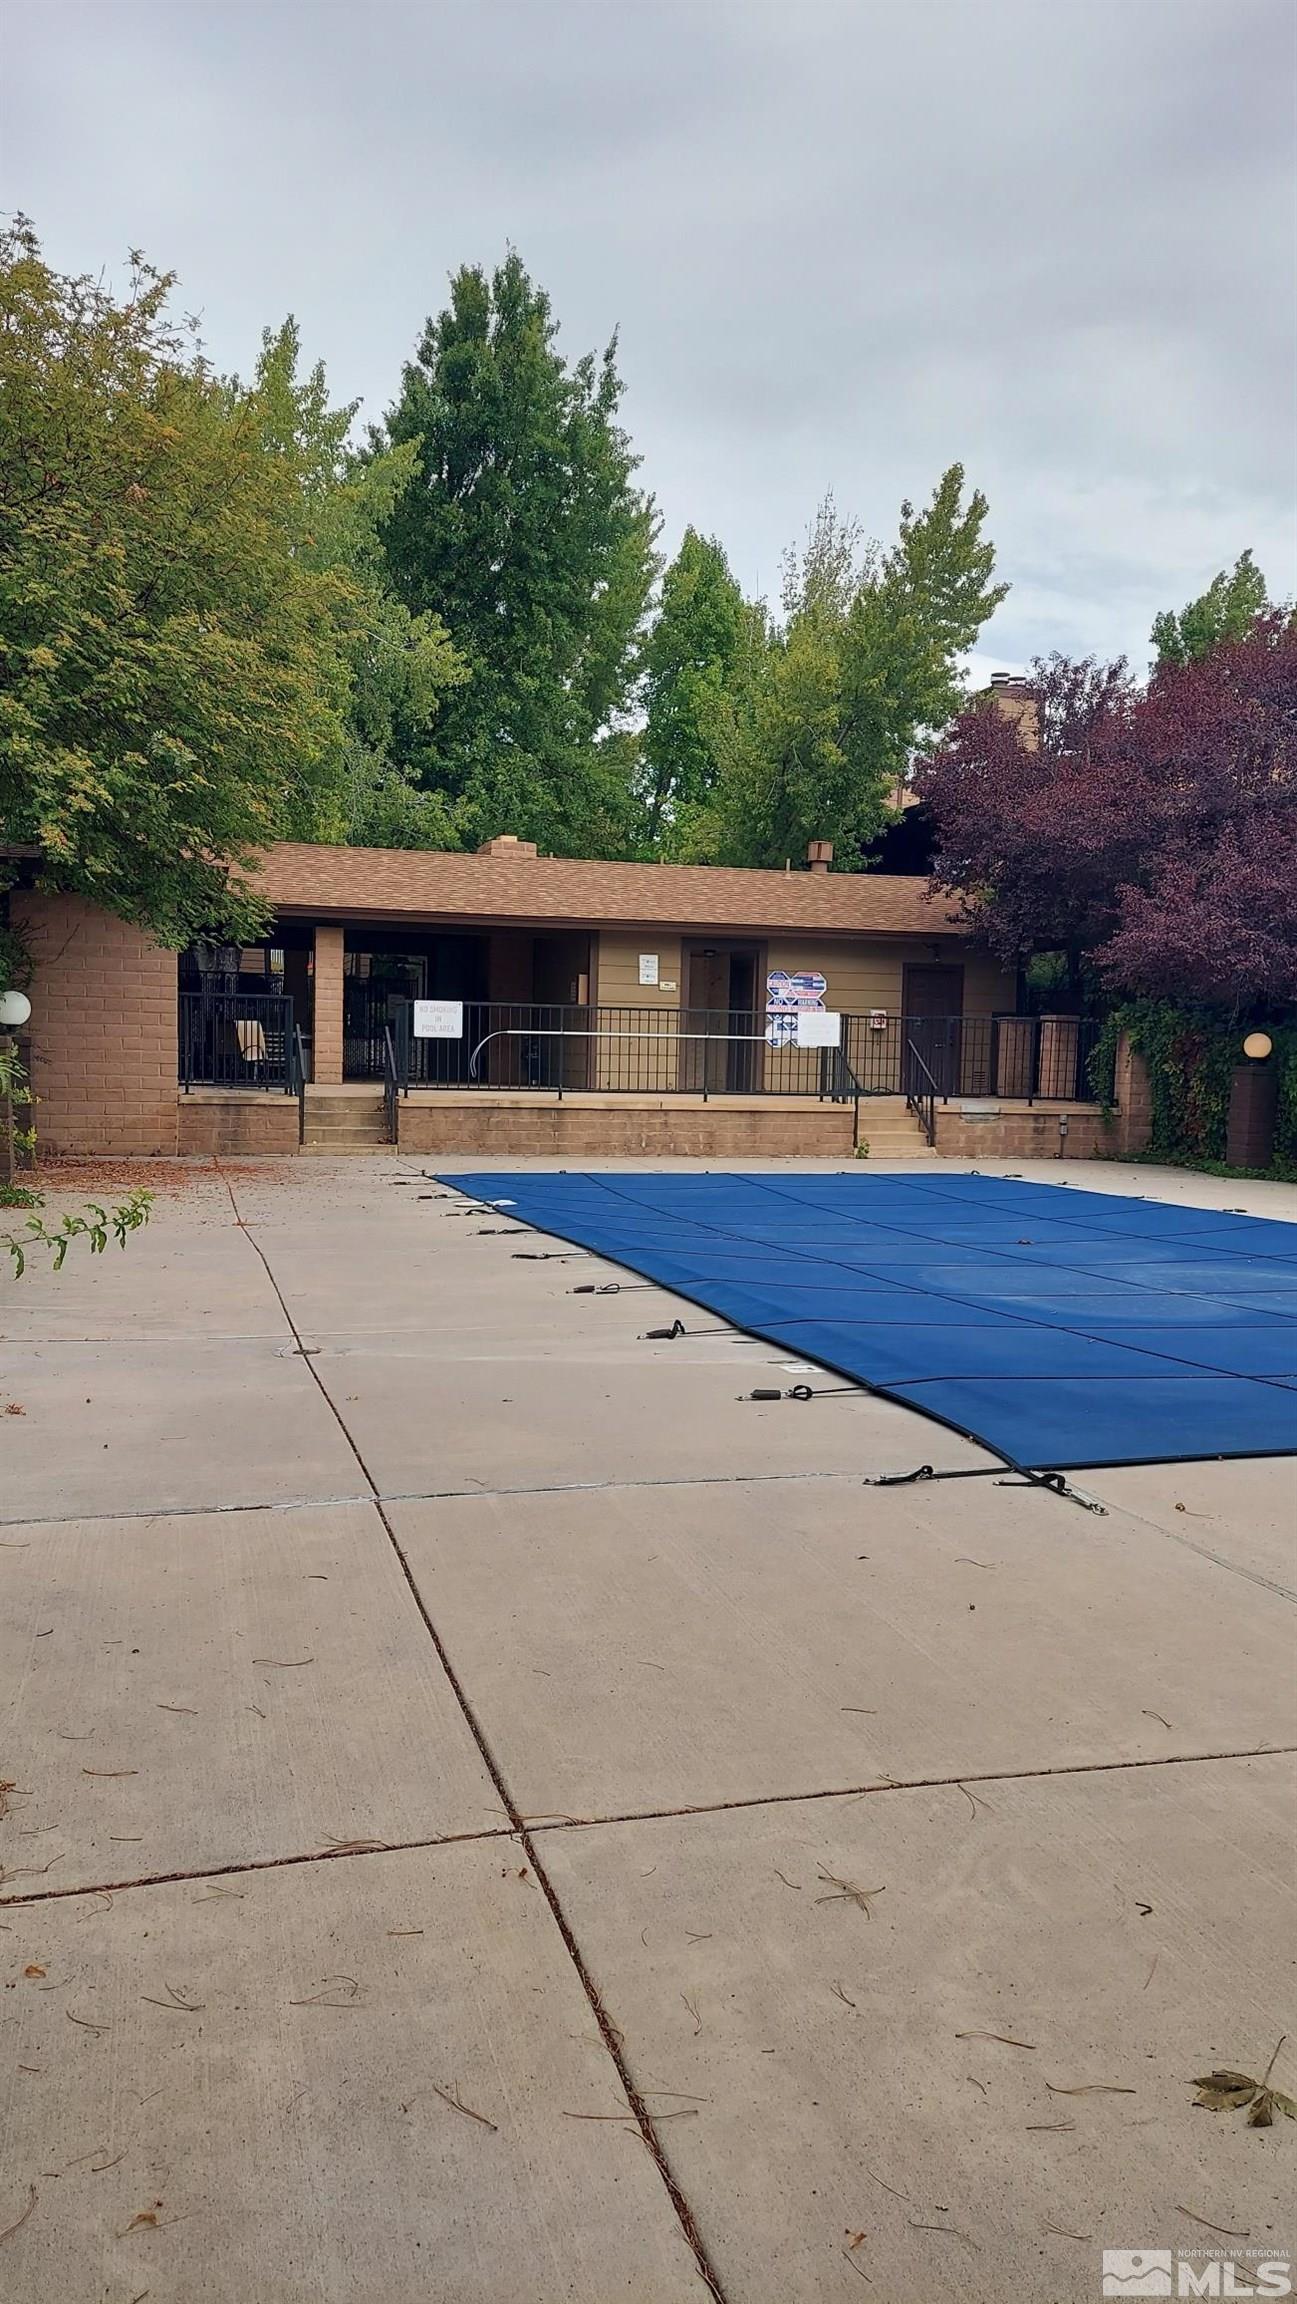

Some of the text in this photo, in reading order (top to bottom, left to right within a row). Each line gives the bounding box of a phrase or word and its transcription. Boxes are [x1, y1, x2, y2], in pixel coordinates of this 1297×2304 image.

[429, 1006, 458, 1014] SMOKING
[421, 1024, 455, 1032] POOL AREA
